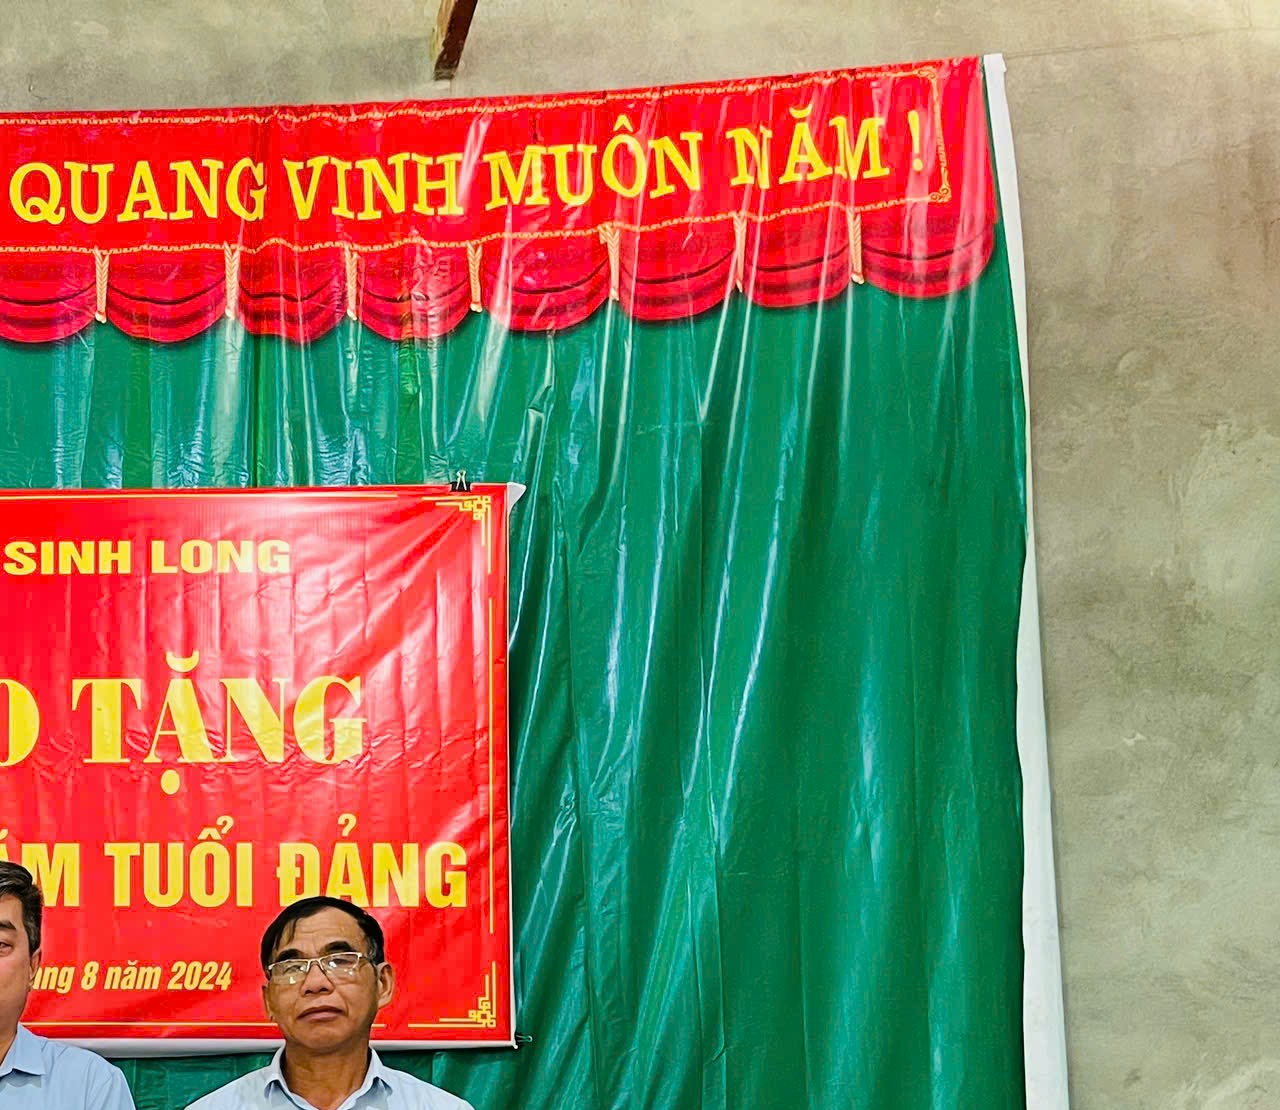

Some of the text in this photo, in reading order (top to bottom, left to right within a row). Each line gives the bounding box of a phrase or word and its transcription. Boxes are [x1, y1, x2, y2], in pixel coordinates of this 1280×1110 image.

[9, 157, 267, 225] QUANG
[283, 151, 464, 220] VINH
[484, 116, 703, 209] MUÔN
[726, 107, 889, 189] NĂM
[3, 539, 131, 575] SINH
[151, 539, 290, 574] LONG
[72, 650, 363, 795] TẶNG
[105, 815, 252, 908] TUỔI
[276, 813, 467, 908] ĐẢNG
[81, 960, 99, 990] 8
[104, 960, 161, 990] năm
[167, 960, 231, 990] 2024
